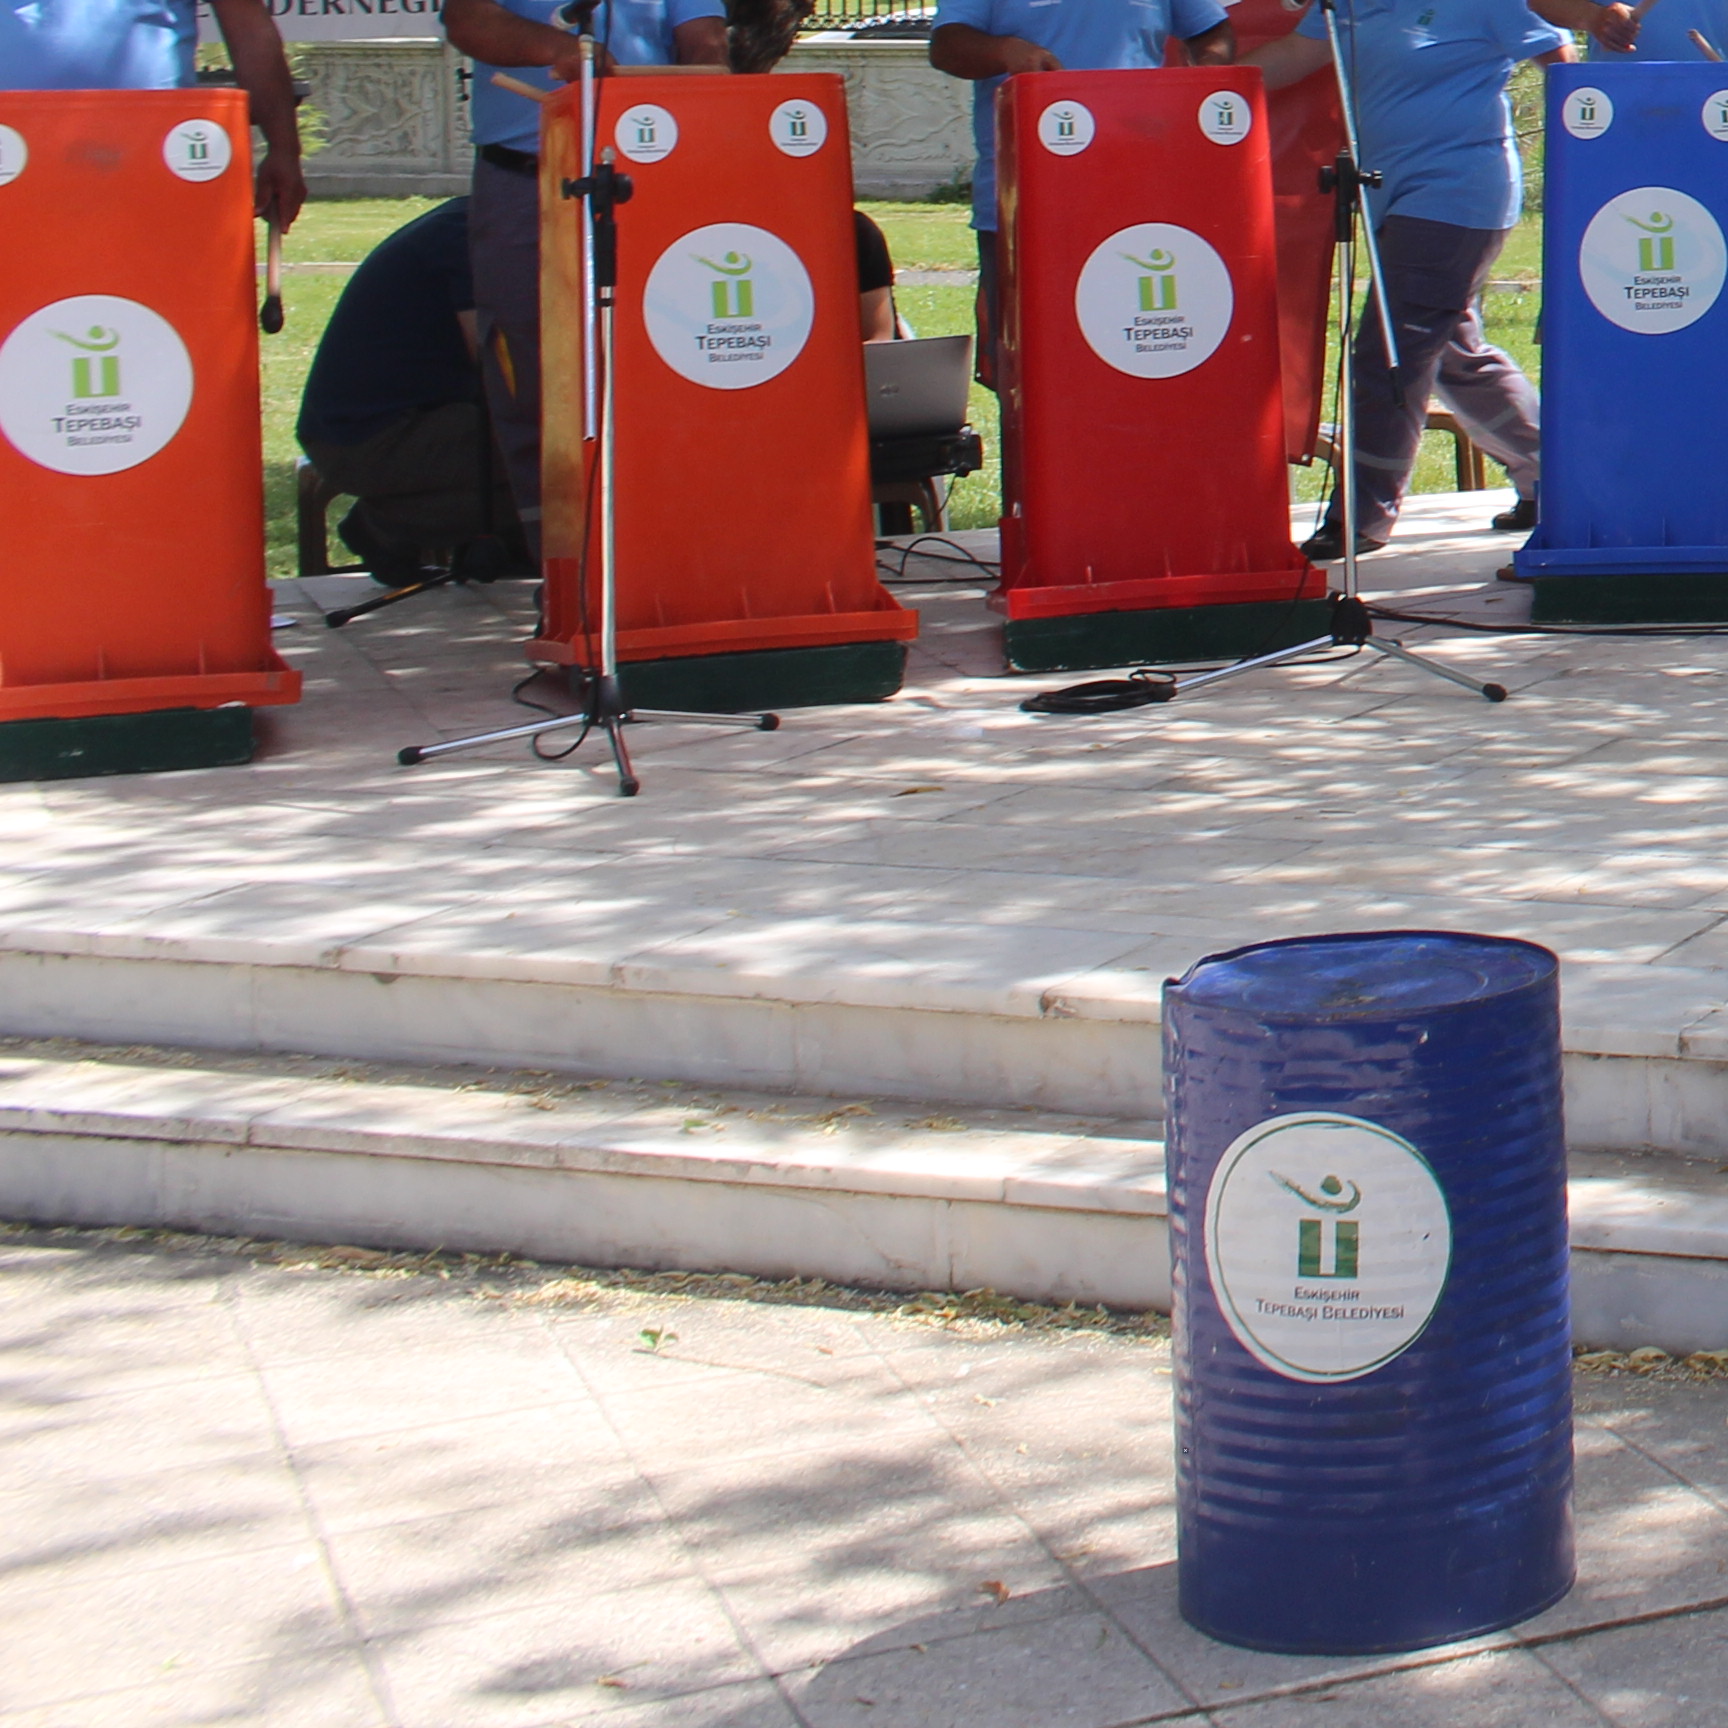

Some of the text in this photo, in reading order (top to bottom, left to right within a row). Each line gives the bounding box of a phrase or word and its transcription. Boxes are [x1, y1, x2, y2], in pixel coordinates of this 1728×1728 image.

[1623, 286, 1690, 299] TEPEBAŞI
[694, 334, 772, 351] TEPEBAŞI
[1122, 327, 1194, 341] TEPEBAŞI
[50, 415, 142, 433] TEPEBAŞI
[1294, 1286, 1361, 1303] ESKİŞEHİR
[1256, 1298, 1405, 1322] TEPEBAŞI BELEDİYESİ
